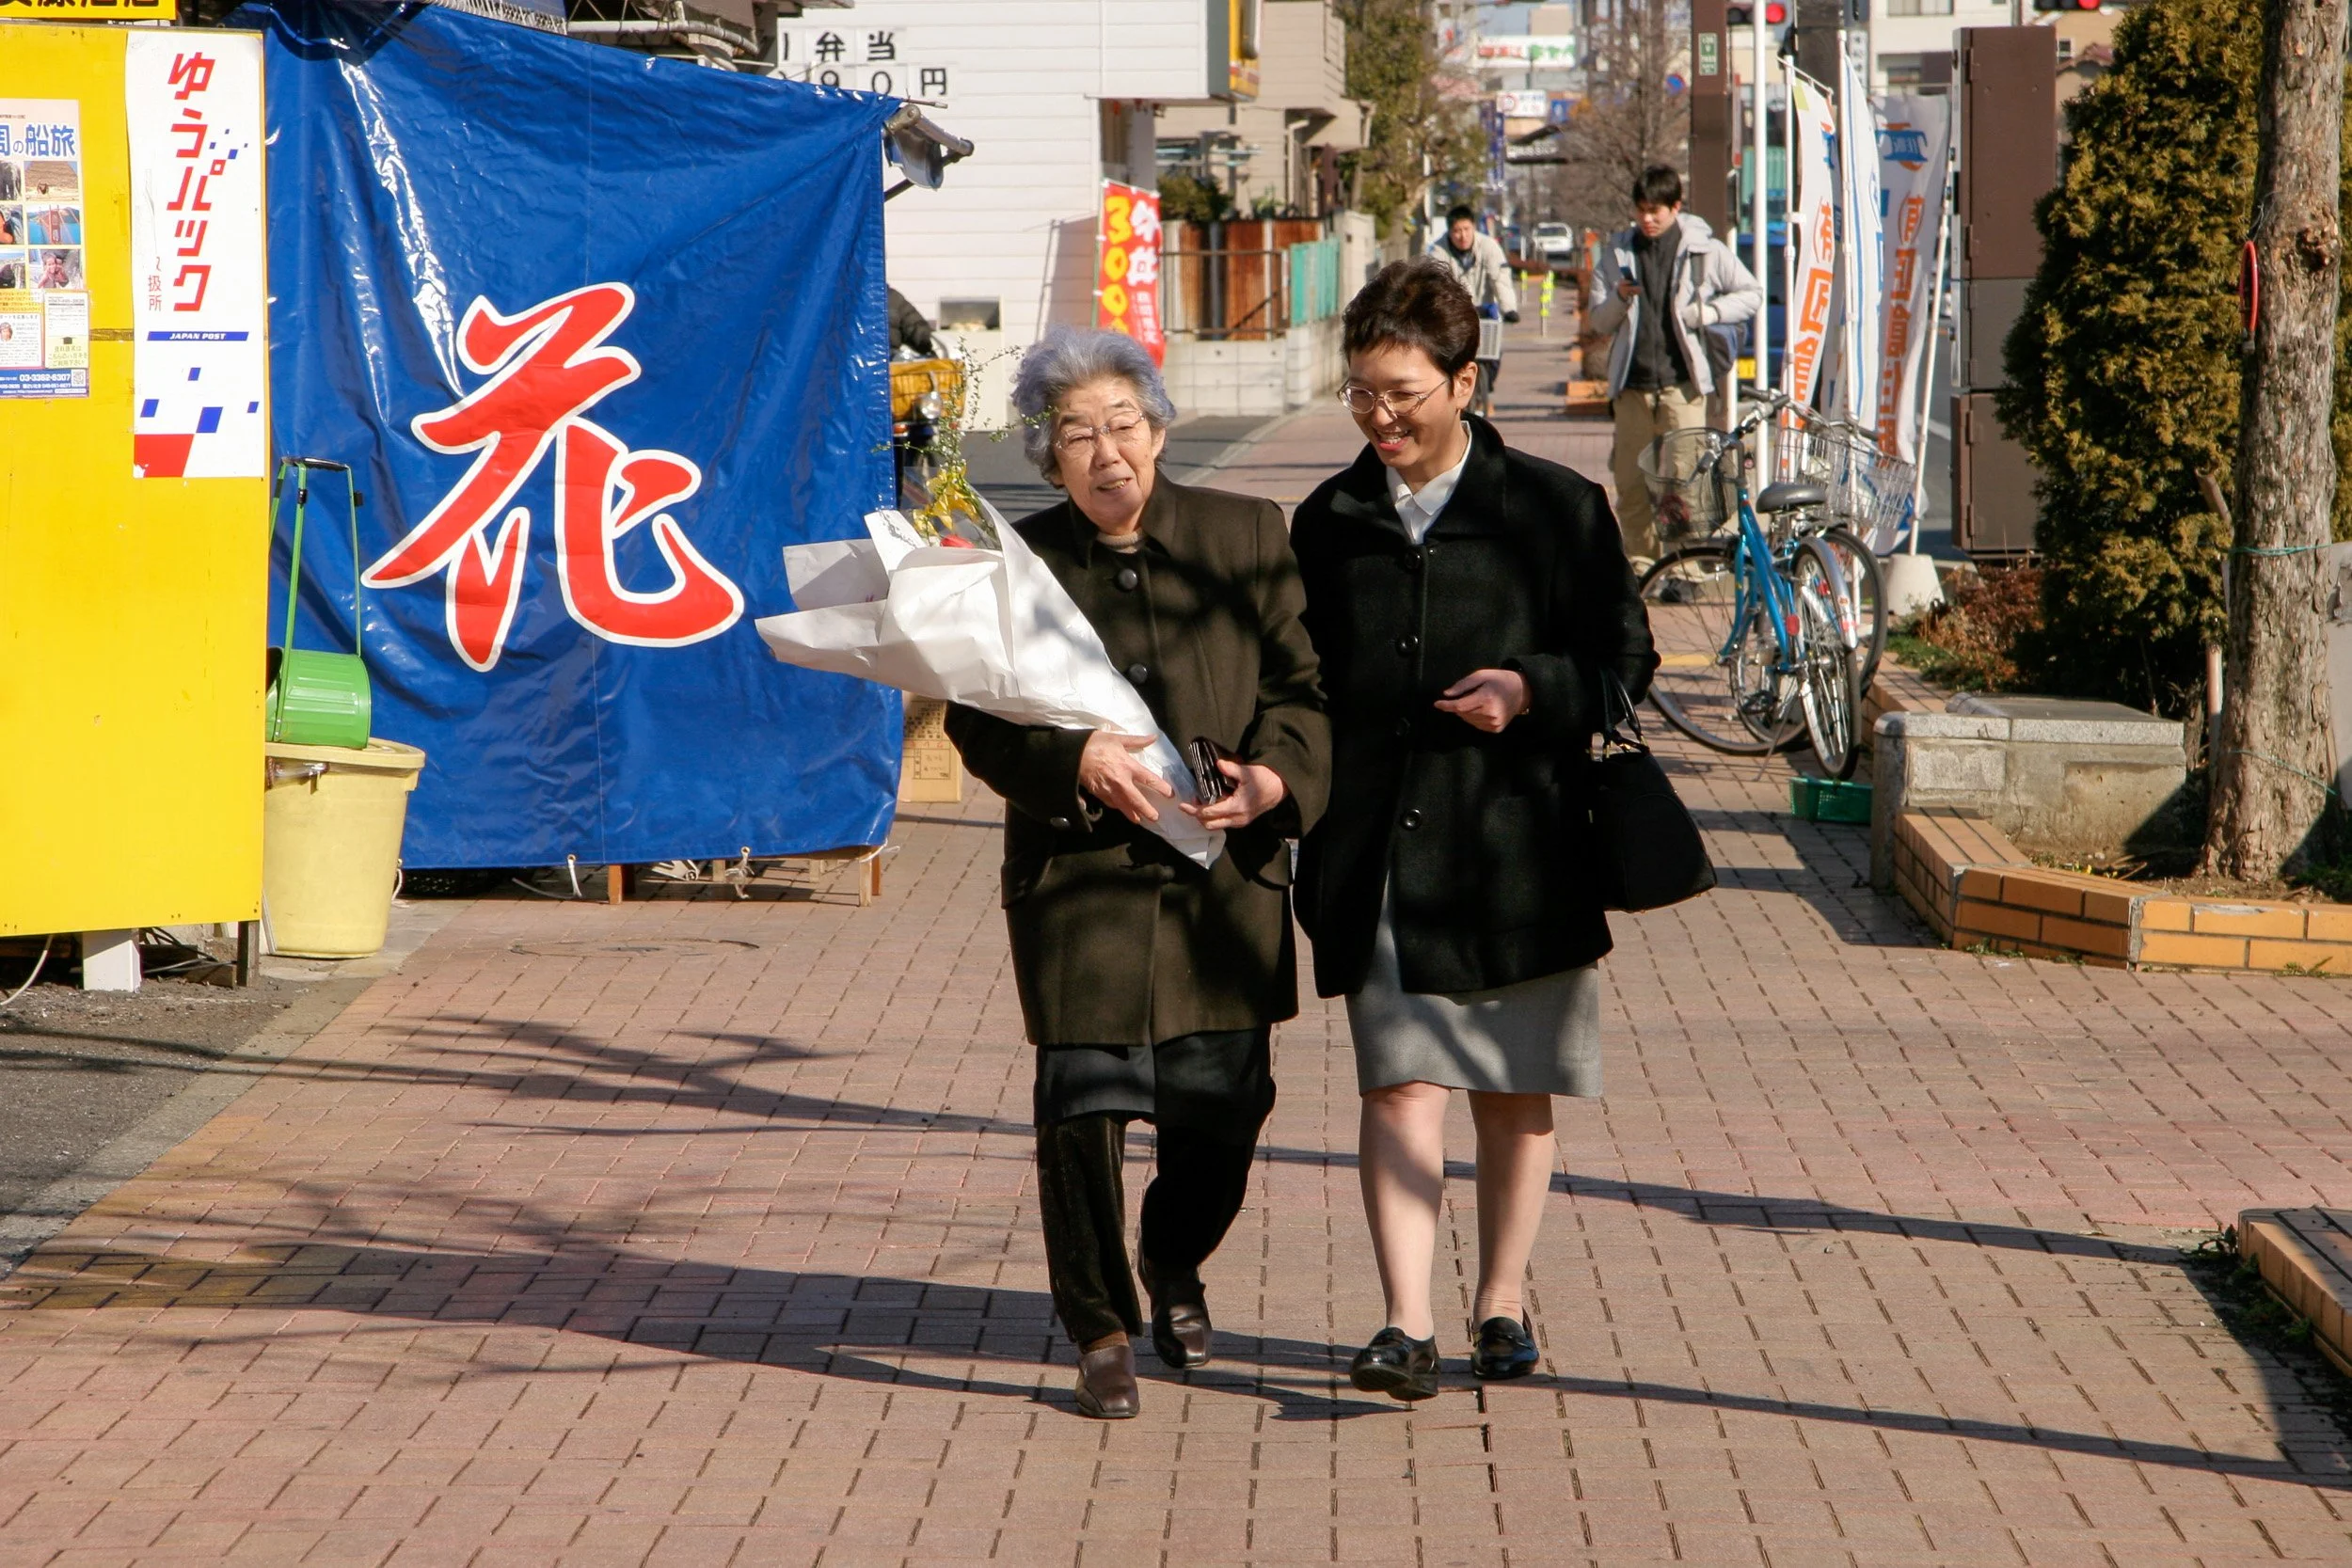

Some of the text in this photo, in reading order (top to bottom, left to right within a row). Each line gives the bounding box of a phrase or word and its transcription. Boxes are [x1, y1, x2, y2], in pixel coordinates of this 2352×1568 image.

[166, 52, 227, 311] ゆうパック
[779, 68, 946, 96] 90円
[360, 282, 744, 672] 花
